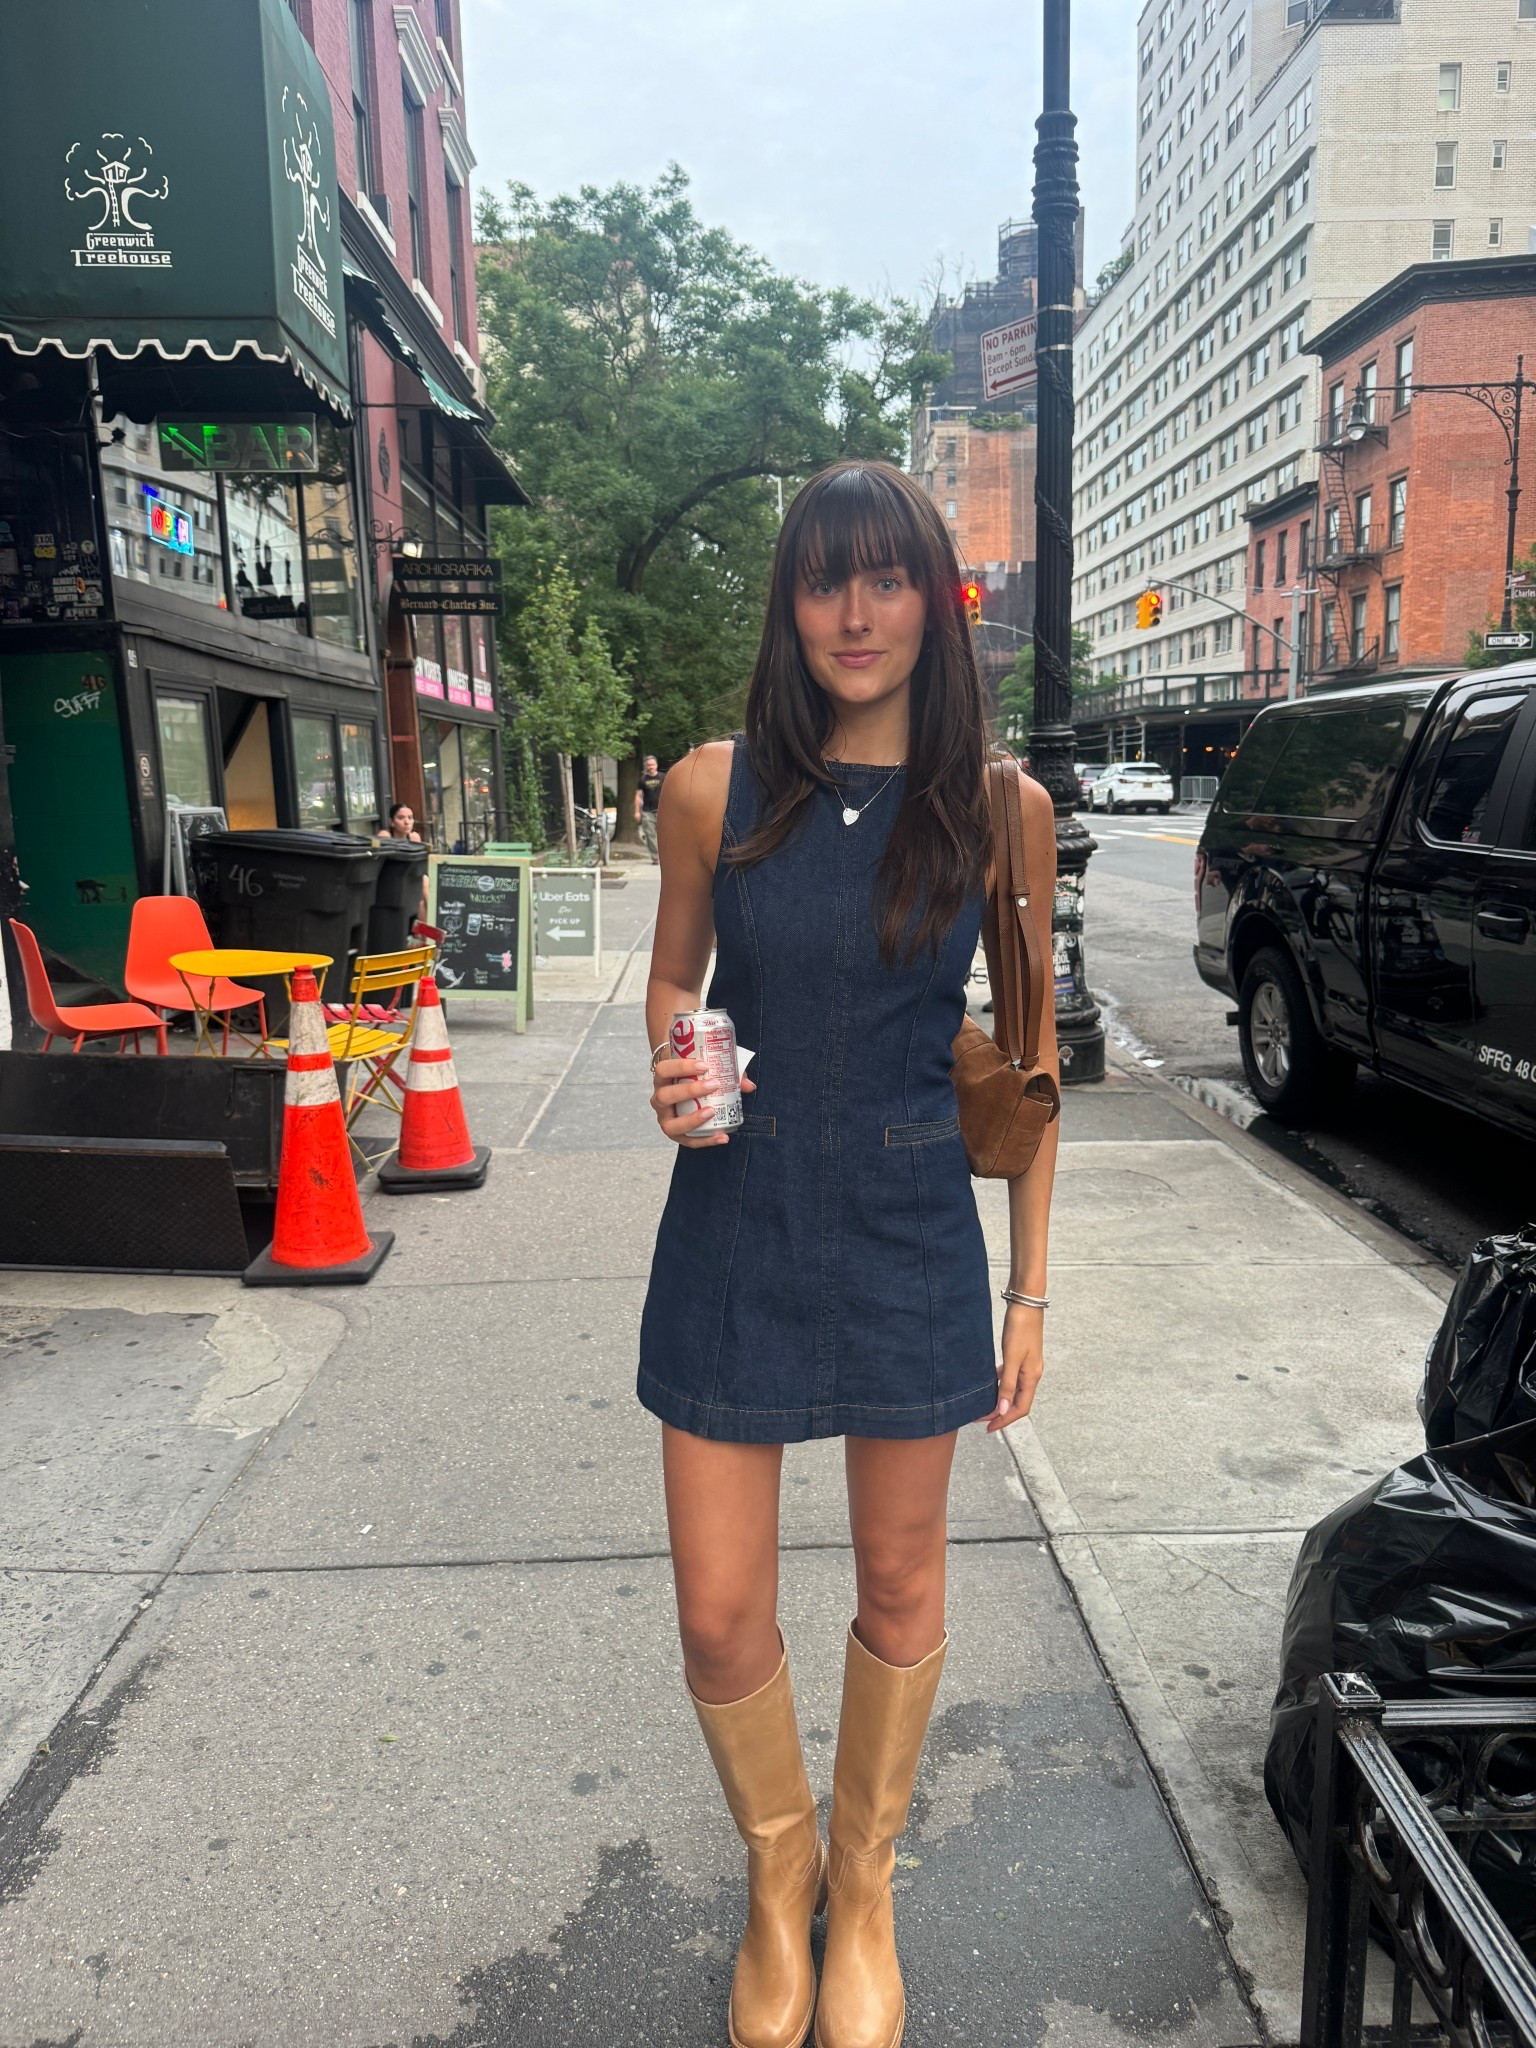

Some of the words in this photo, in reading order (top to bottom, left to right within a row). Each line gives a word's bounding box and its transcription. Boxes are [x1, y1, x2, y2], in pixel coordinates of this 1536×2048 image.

[86, 232, 154, 250] Greenwich
[71, 249, 172, 267] Treehouse
[297, 244, 328, 300] Greenwich
[291, 263, 336, 337] Treehouse
[986, 336, 999, 351] NO
[1002, 321, 1037, 345] PARKIN
[987, 353, 1003, 365] 8am
[1009, 344, 1026, 357] 6pm
[988, 359, 1013, 377] Except
[1014, 352, 1037, 368] Sund
[202, 425, 317, 470] BAR
[402, 563, 494, 576] ARCHIGRAFIKA
[1514, 589, 1536, 598] Charles
[478, 599, 499, 610] Inc.
[1491, 636, 1505, 644] ONE
[1511, 635, 1525, 643] WAY
[228, 864, 264, 896] 46
[540, 891, 564, 901] Uber
[565, 891, 590, 901] Eats
[550, 917, 568, 925] PICK
[570, 917, 581, 925] UP
[1479, 1045, 1512, 1073] SFFG
